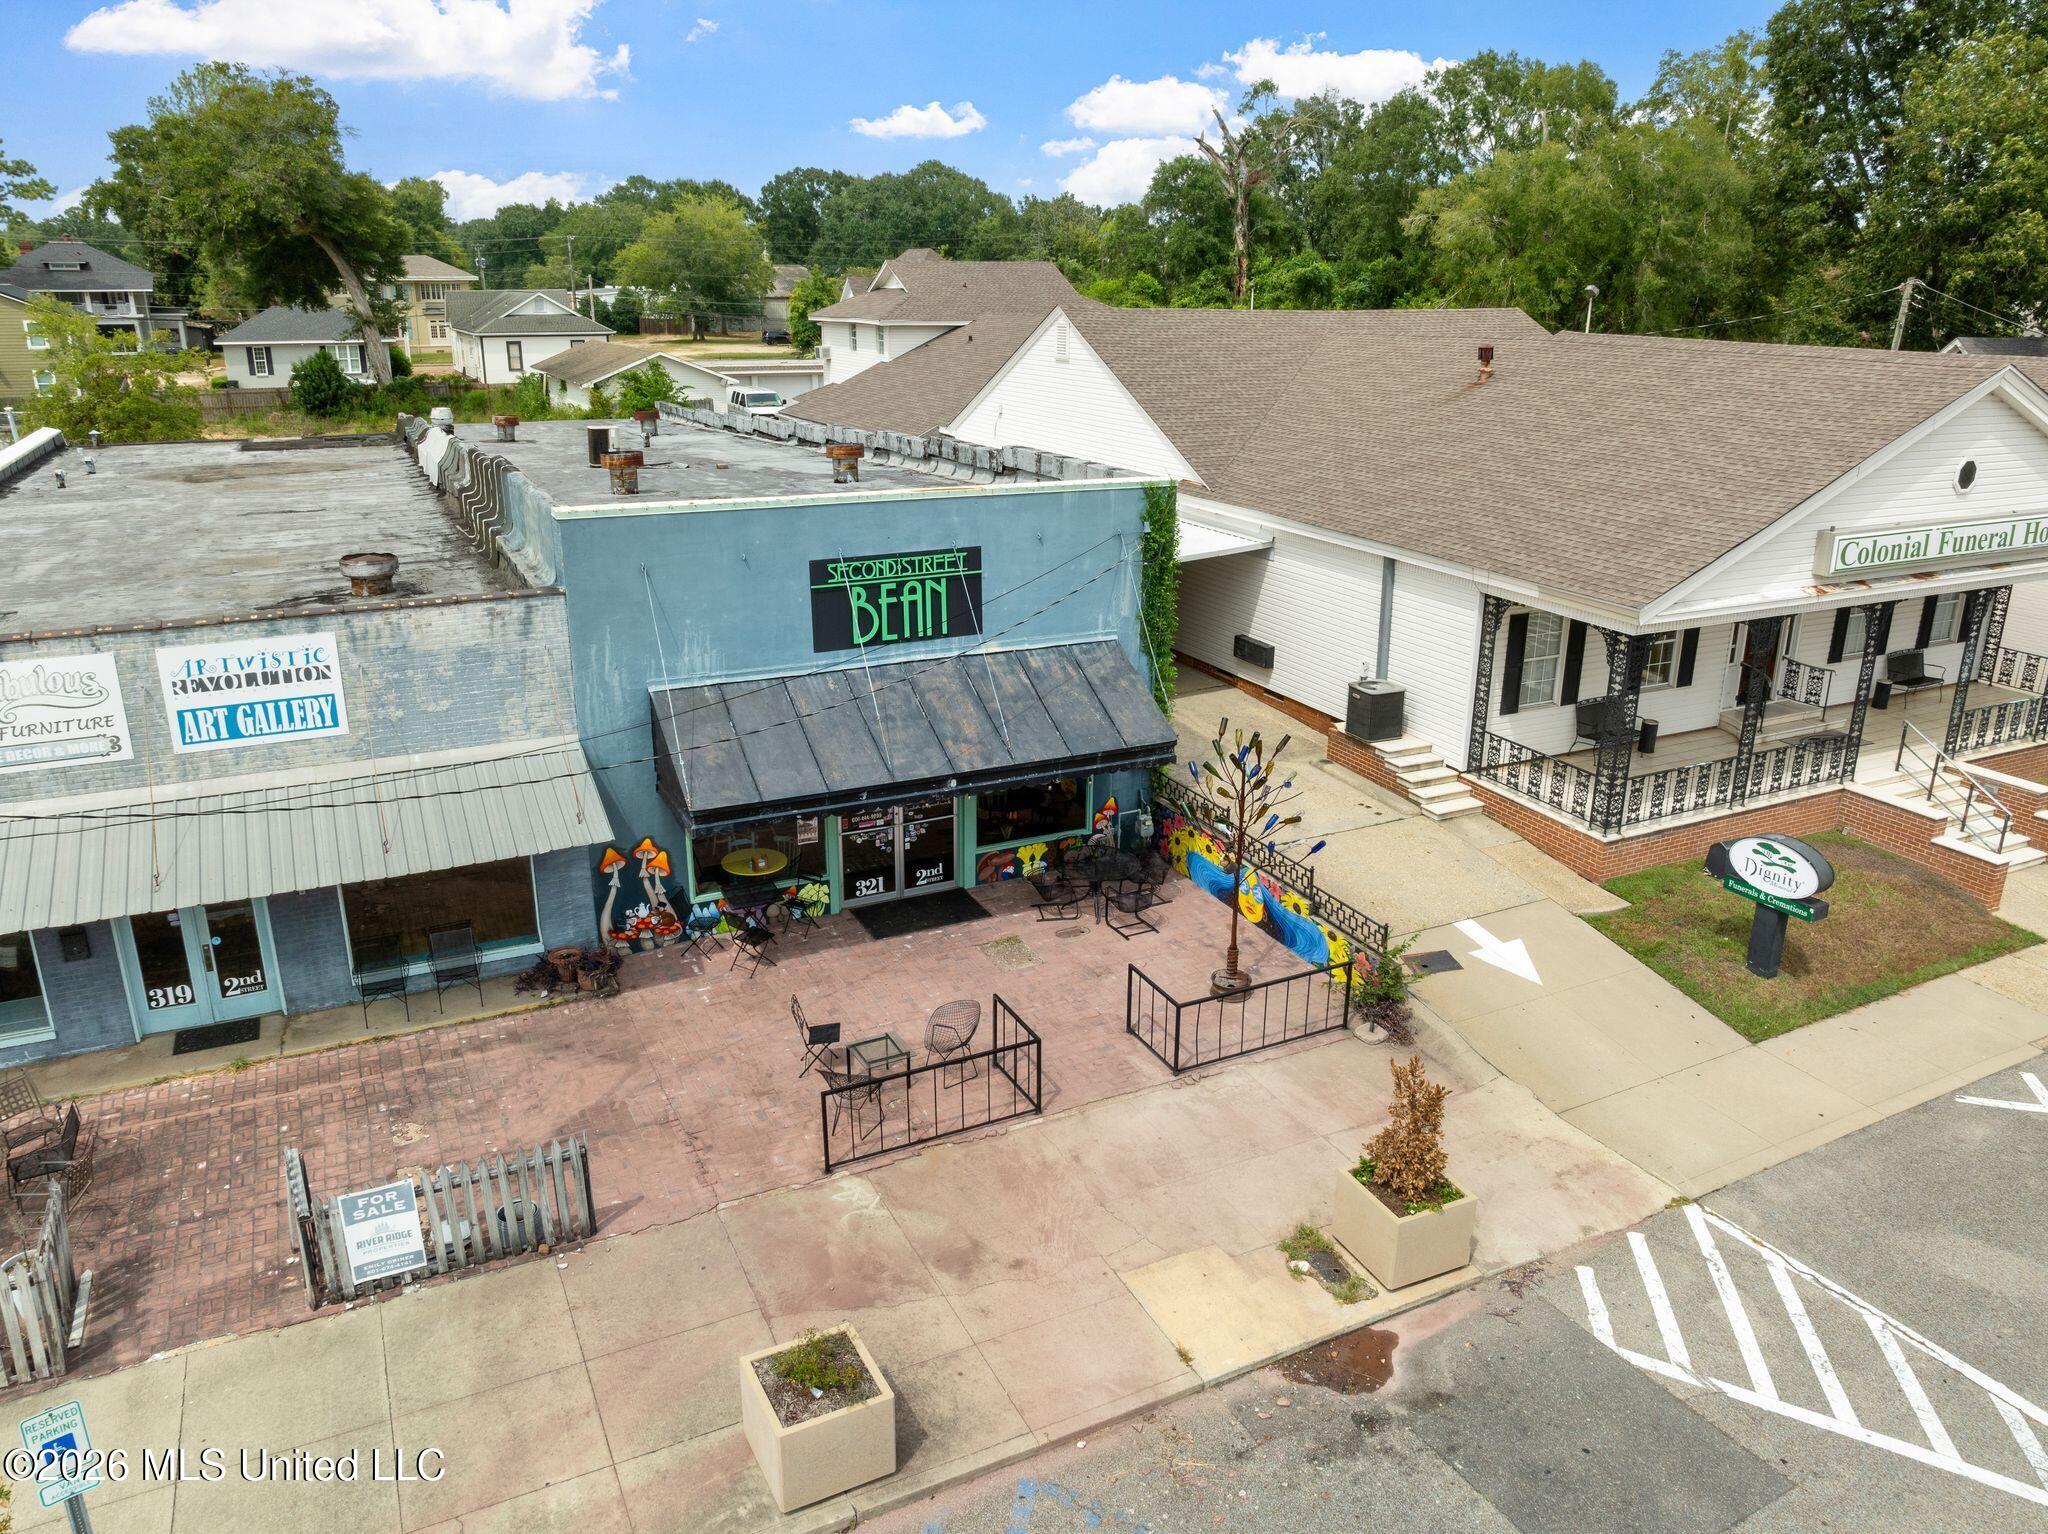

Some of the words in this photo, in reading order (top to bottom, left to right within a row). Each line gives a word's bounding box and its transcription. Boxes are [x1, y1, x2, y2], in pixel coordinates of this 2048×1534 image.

[1840, 533, 1930, 567] Colonial
[1937, 525, 2016, 555] Funeral
[827, 558, 896, 583] SECOND
[899, 552, 968, 575] STREET
[851, 578, 948, 645] BEAN
[172, 664, 332, 696] REVOLUTION
[0, 714, 114, 742] FURNITURE
[183, 707, 230, 743] ART
[236, 695, 333, 737] GALLERY
[68, 740, 106, 756] MORE
[855, 876, 886, 897] 321
[915, 862, 944, 886] 2nd
[1745, 857, 1803, 894] Dignity
[1728, 879, 1758, 898] Funerals
[1759, 891, 1766, 900] &
[1767, 894, 1808, 918] Cremations
[148, 984, 193, 1009] 319
[223, 969, 264, 997] 2nd
[239, 984, 265, 994] STREET
[352, 1200, 406, 1220] SALE
[357, 1191, 398, 1209] FOR
[356, 1233, 384, 1250] RIVER
[386, 1229, 414, 1244] RIDGE
[24, 1407, 79, 1435] RESERVED
[31, 1419, 78, 1444] PARKING
